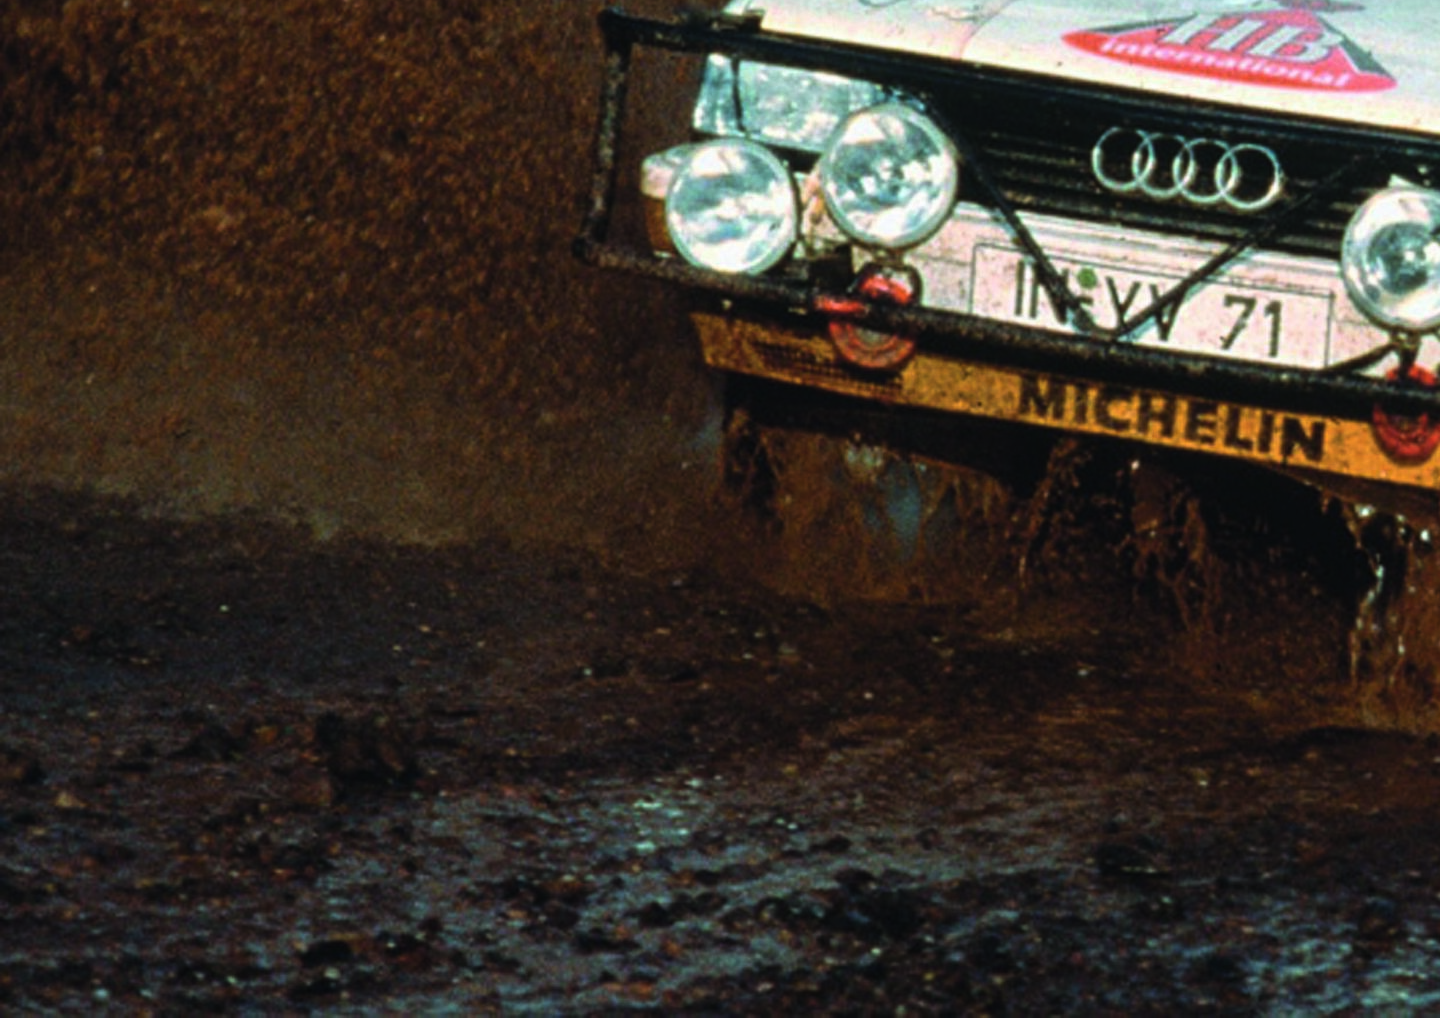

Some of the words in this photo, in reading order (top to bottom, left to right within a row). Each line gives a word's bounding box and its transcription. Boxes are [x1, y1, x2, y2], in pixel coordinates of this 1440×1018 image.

[1160, 12, 1342, 63] HB
[1223, 294, 1283, 359] 71
[1020, 374, 1327, 462] MICHELIN
